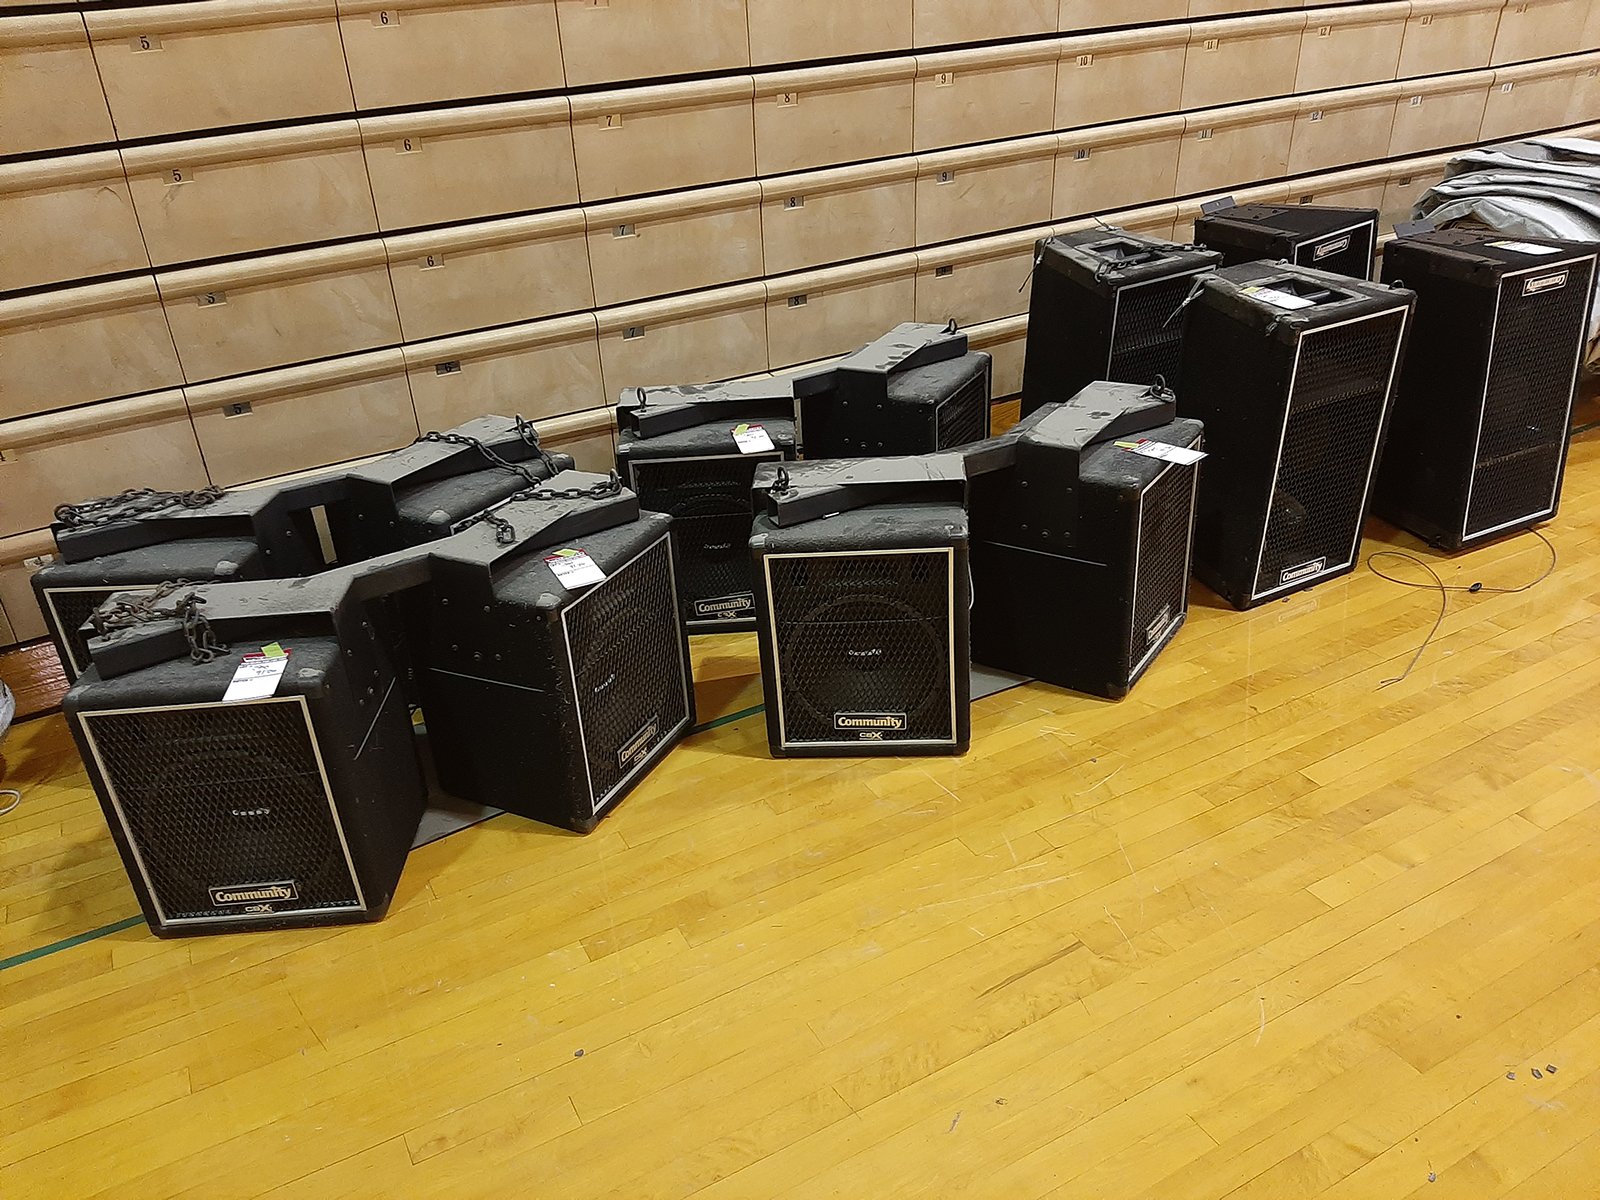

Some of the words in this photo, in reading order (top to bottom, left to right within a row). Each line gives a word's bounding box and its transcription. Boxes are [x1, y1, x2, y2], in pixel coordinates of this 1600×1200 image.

[380, 11, 389, 25] 6
[140, 35, 150, 50] 5
[1079, 55, 1088, 66] 10
[941, 73, 947, 84] 9
[784, 93, 790, 103] 8
[606, 115, 613, 127] 7
[404, 138, 412, 151] 6
[172, 169, 182, 182] 5
[942, 171, 948, 182] 9
[790, 196, 796, 207] 8
[619, 224, 626, 236] 7
[427, 255, 434, 267] 6
[629, 327, 636, 337] 7
[233, 403, 242, 415] 5
[698, 598, 751, 612] Community
[837, 716, 902, 729] Community
[214, 885, 291, 902] Community
